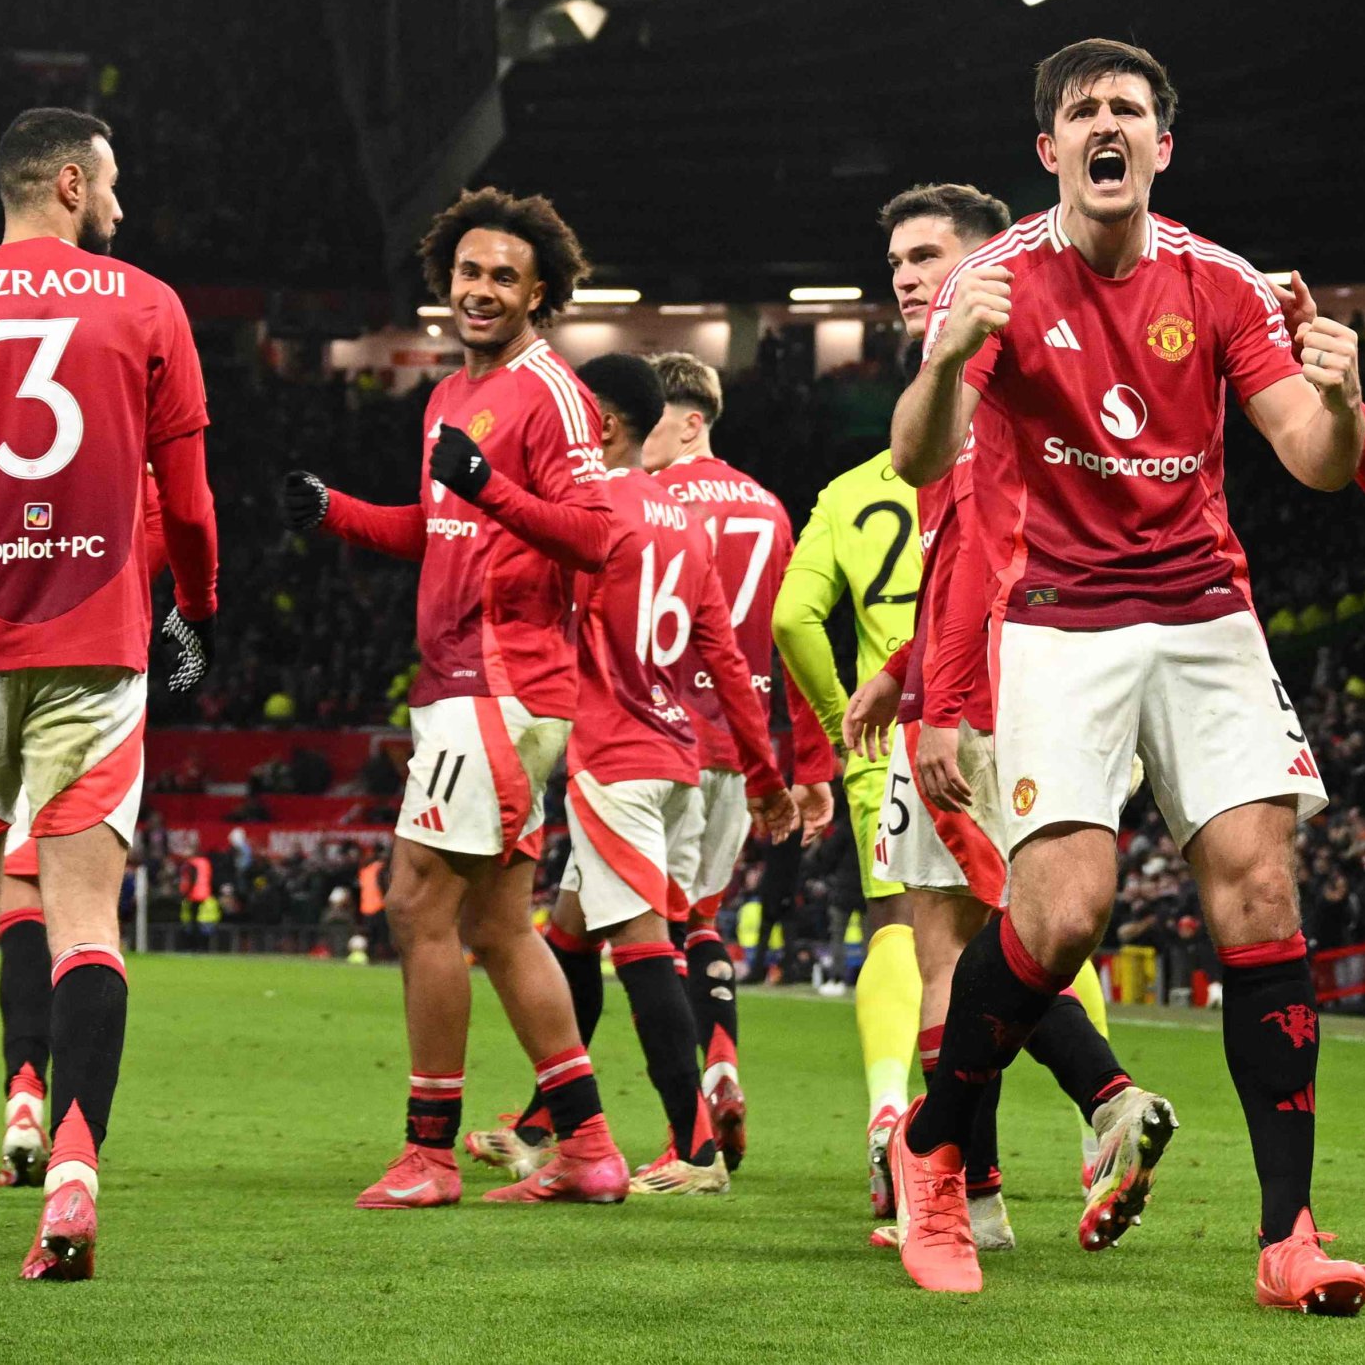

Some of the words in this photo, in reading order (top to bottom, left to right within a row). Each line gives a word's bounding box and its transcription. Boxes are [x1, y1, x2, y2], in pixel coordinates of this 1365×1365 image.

[643, 499, 687, 532] AMAD
[668, 479, 776, 508] GARNACHO
[635, 541, 692, 668] 16
[426, 749, 466, 804] 11
